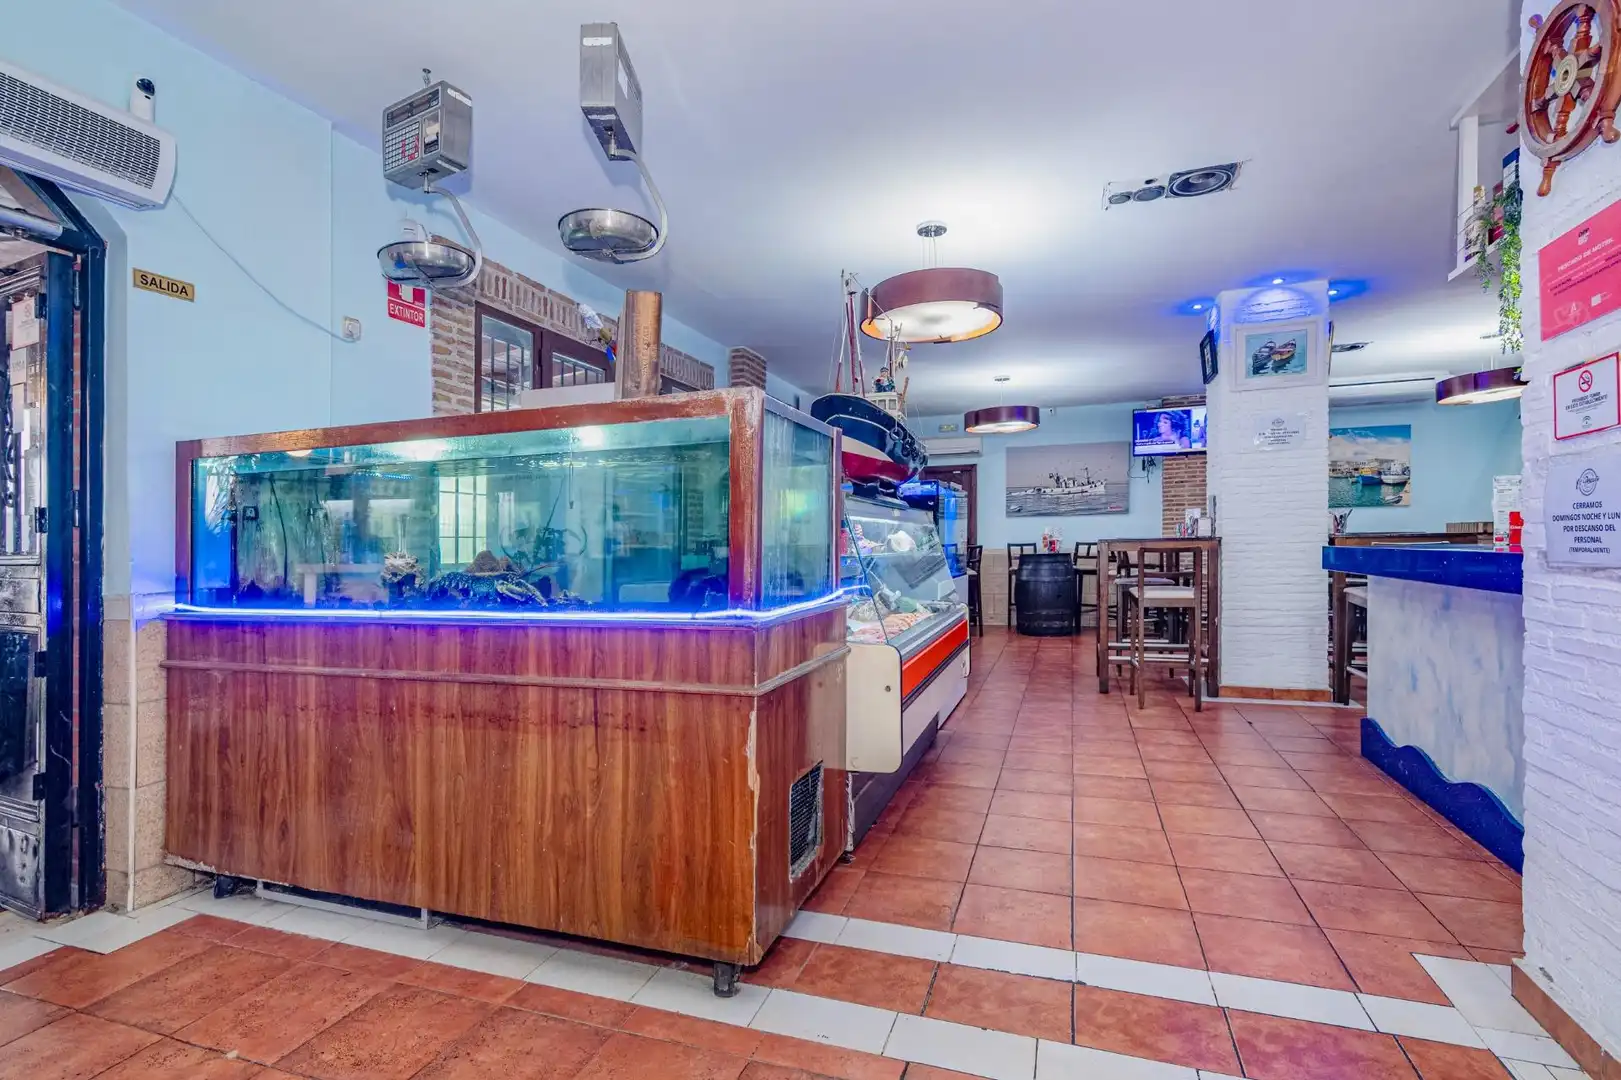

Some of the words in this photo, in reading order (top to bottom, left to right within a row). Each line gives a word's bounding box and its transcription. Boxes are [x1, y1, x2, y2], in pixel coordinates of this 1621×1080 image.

[140, 274, 189, 297] SALIDA
[390, 303, 424, 323] EXTINTOR
[1572, 501, 1602, 509] CERRAMOS
[1552, 513, 1580, 521] DOMINGOS
[1581, 512, 1601, 520] NOCHE
[1575, 524, 1603, 532] DESCANSO
[1569, 546, 1611, 554] (TEMPORALMENTE)
